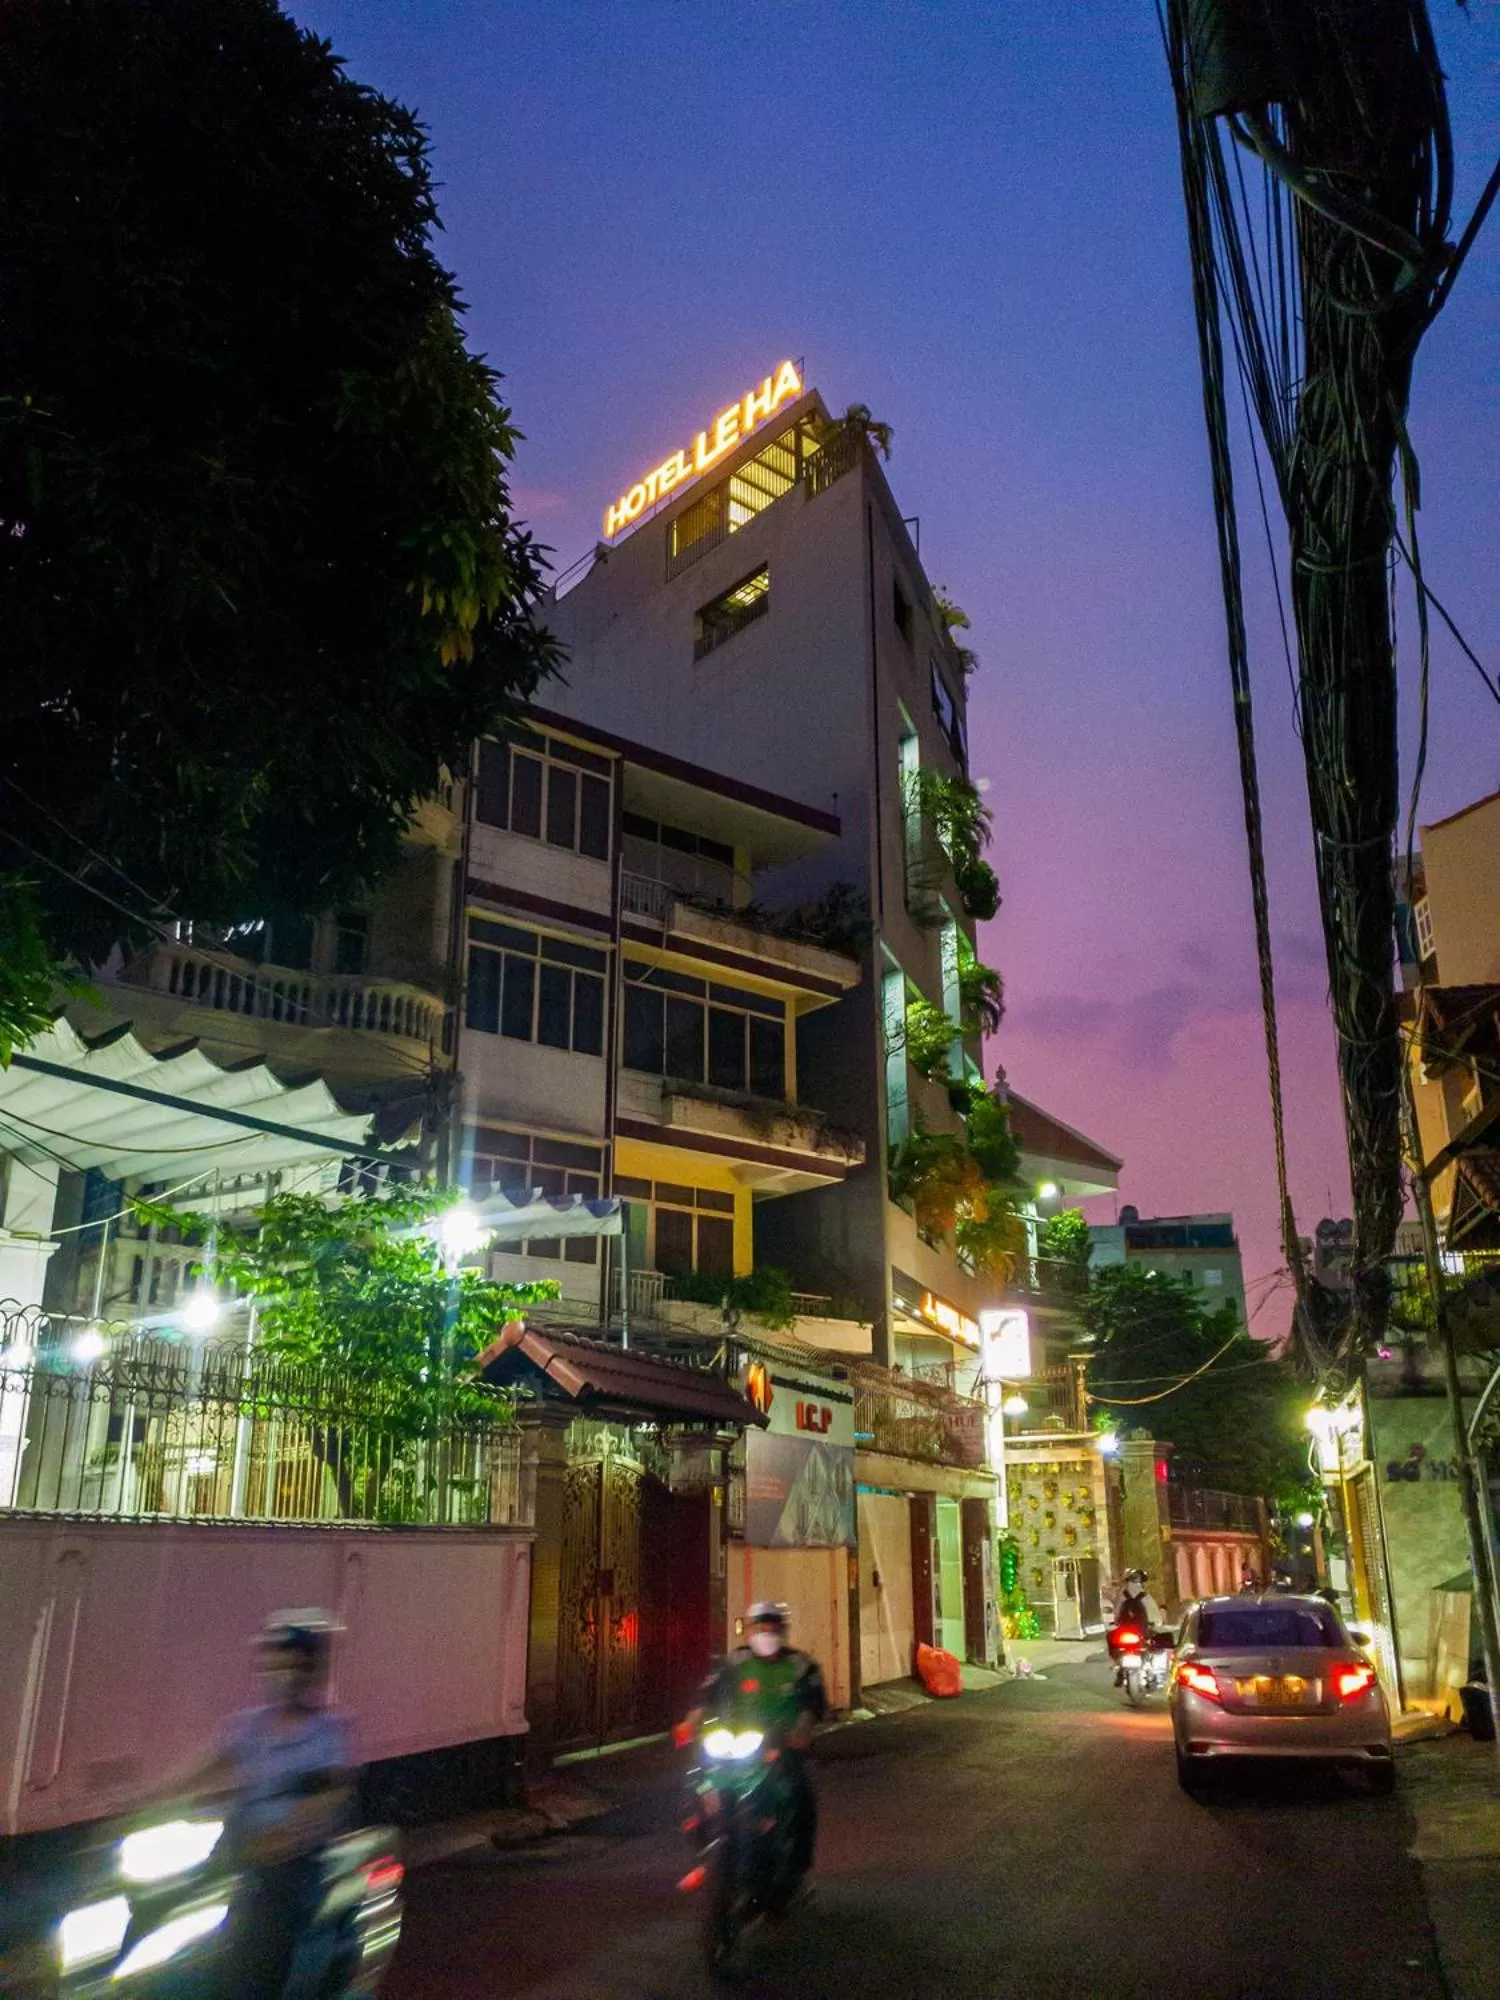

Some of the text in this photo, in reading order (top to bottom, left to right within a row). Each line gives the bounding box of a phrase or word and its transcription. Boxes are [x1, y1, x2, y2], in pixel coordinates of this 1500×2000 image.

[605, 360, 802, 536] HOTEL LE HA
